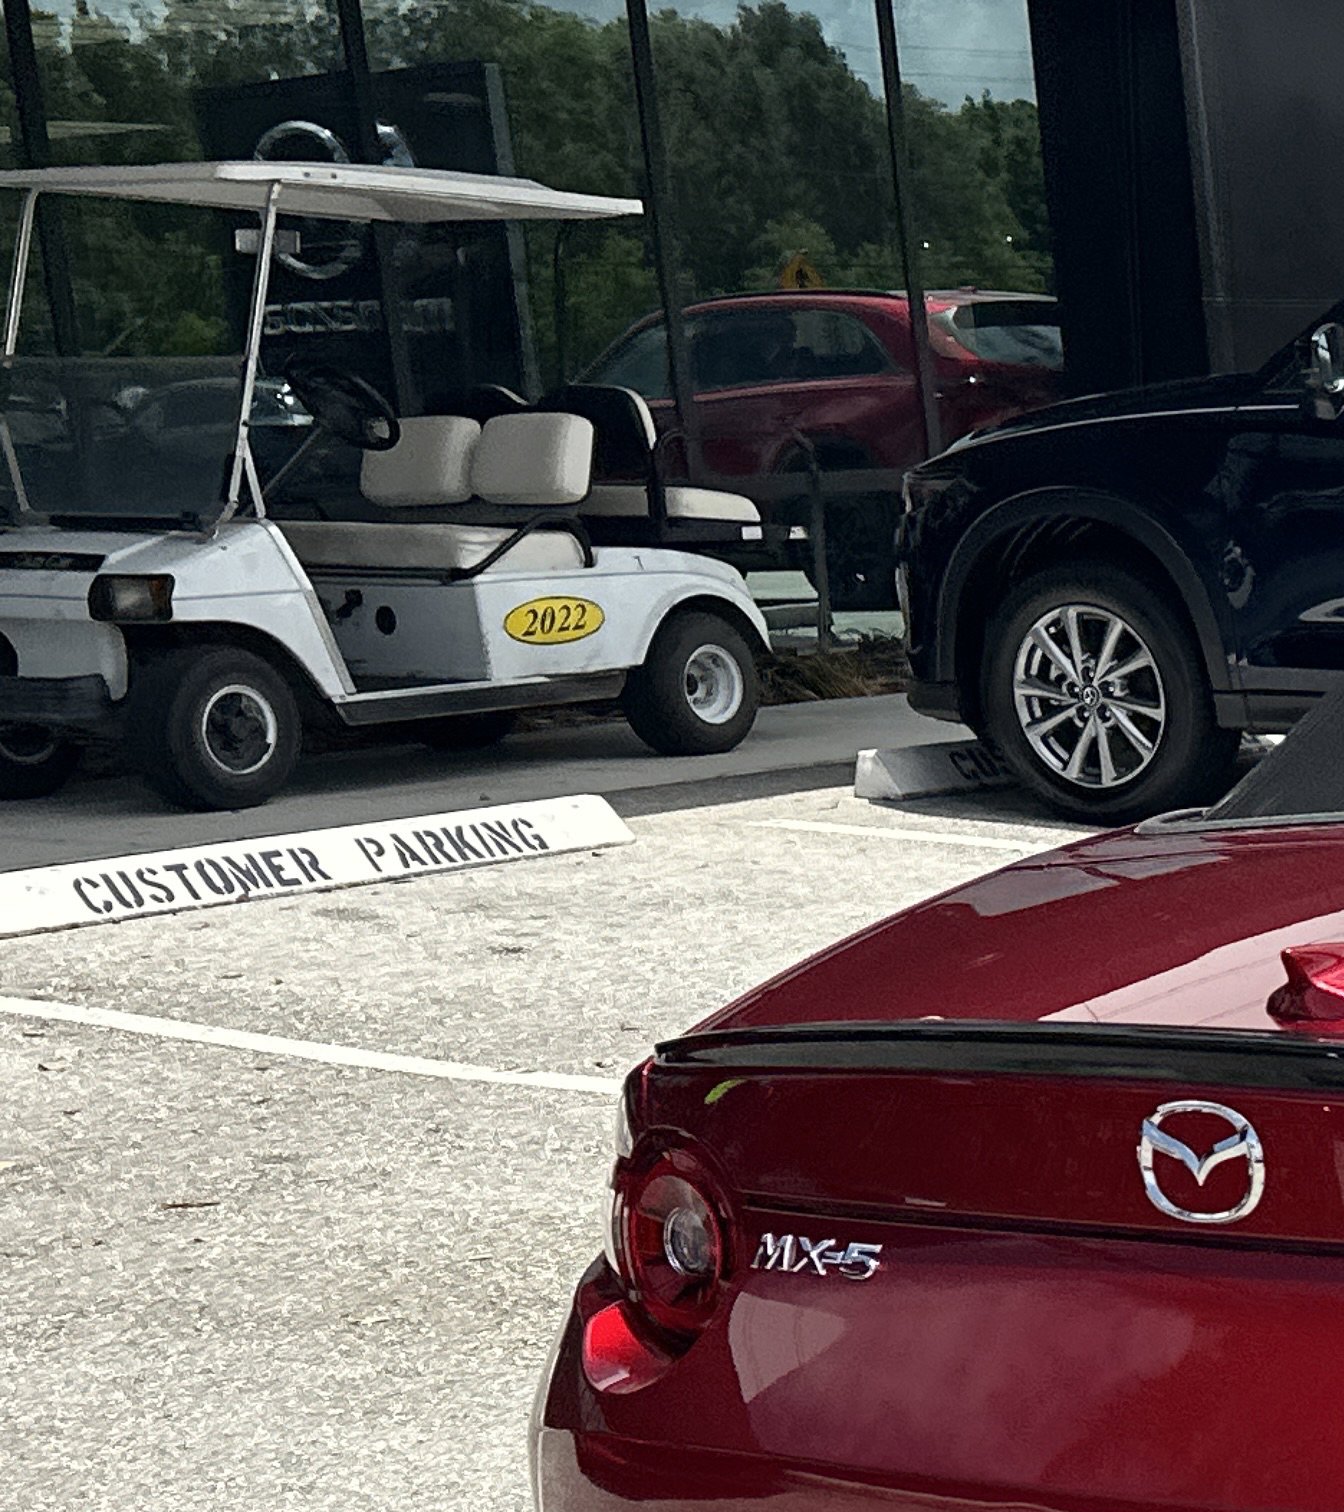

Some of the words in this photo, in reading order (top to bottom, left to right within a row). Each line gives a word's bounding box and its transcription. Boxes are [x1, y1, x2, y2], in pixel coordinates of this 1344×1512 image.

[521, 602, 588, 638] 2022
[72, 847, 334, 915] CUSTOMER
[353, 817, 550, 873] PARKING
[749, 1232, 883, 1280] MX-5
